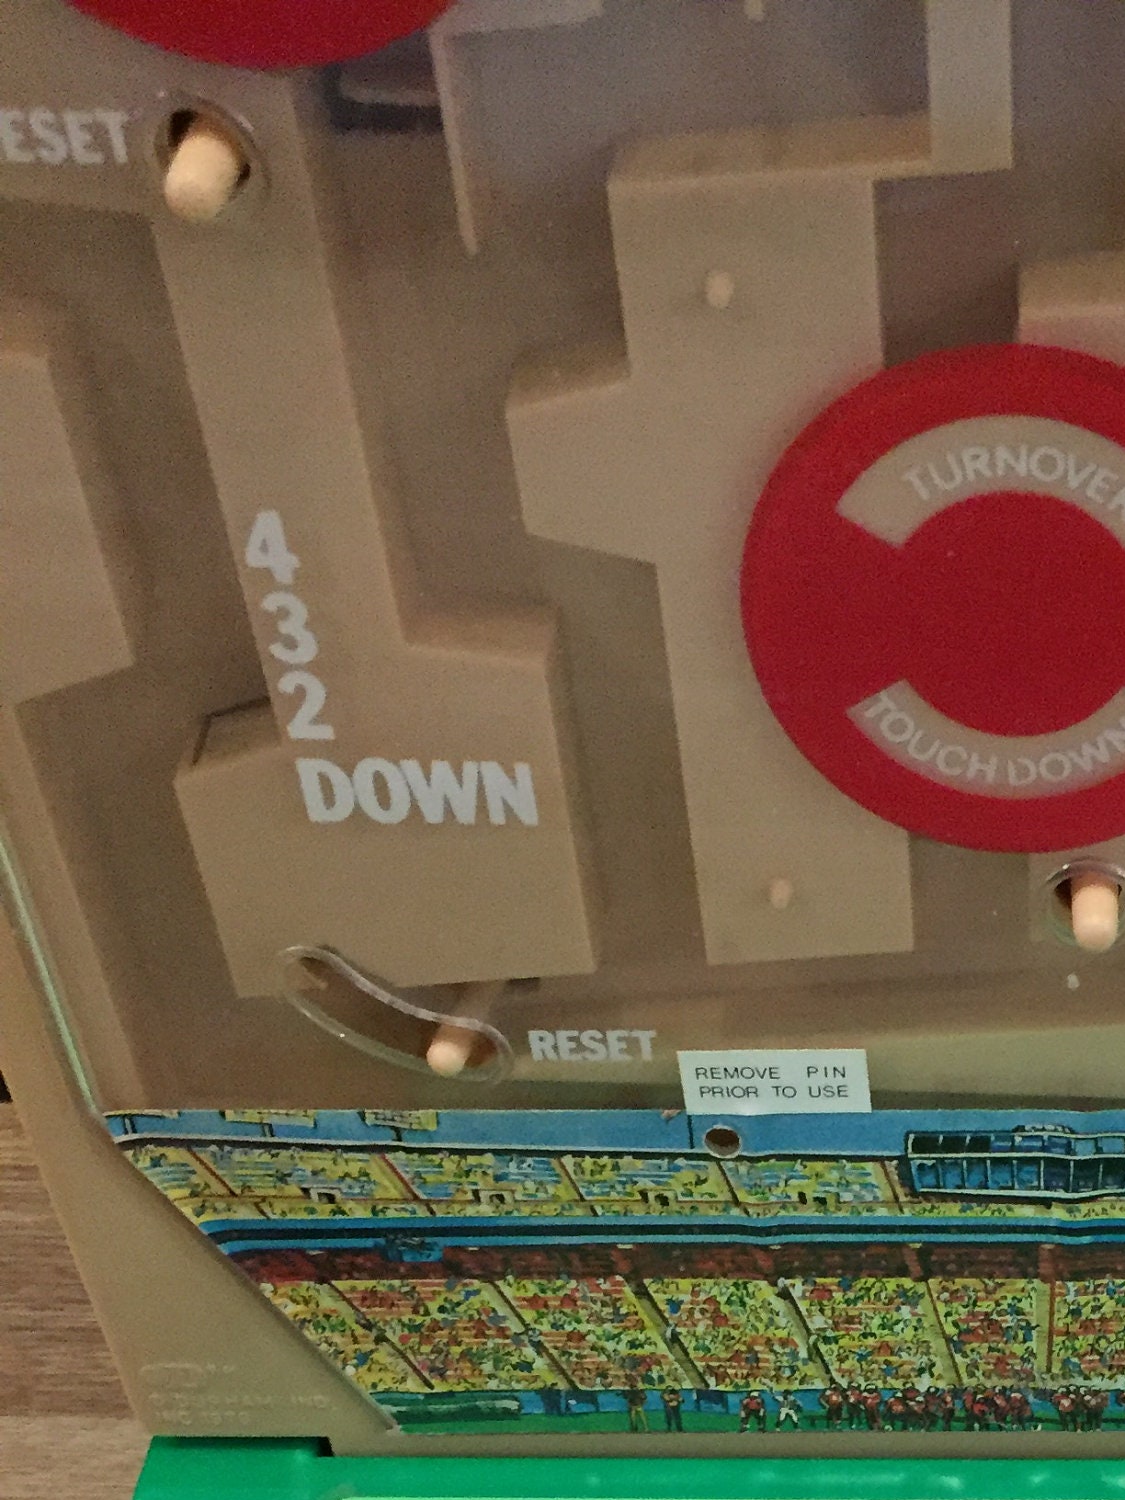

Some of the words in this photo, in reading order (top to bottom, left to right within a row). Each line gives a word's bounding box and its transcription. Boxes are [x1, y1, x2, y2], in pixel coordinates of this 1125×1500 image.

[245, 510, 299, 583] 4
[261, 593, 318, 664] 3
[279, 671, 335, 740] 2
[296, 758, 540, 825] DOWN
[527, 1030, 656, 1062] RESET
[695, 1067, 780, 1080] REMOVE
[806, 1066, 847, 1078] PIN
[700, 1086, 759, 1098] PRIOR
[772, 1086, 797, 1098] TO
[808, 1085, 849, 1098] USE
